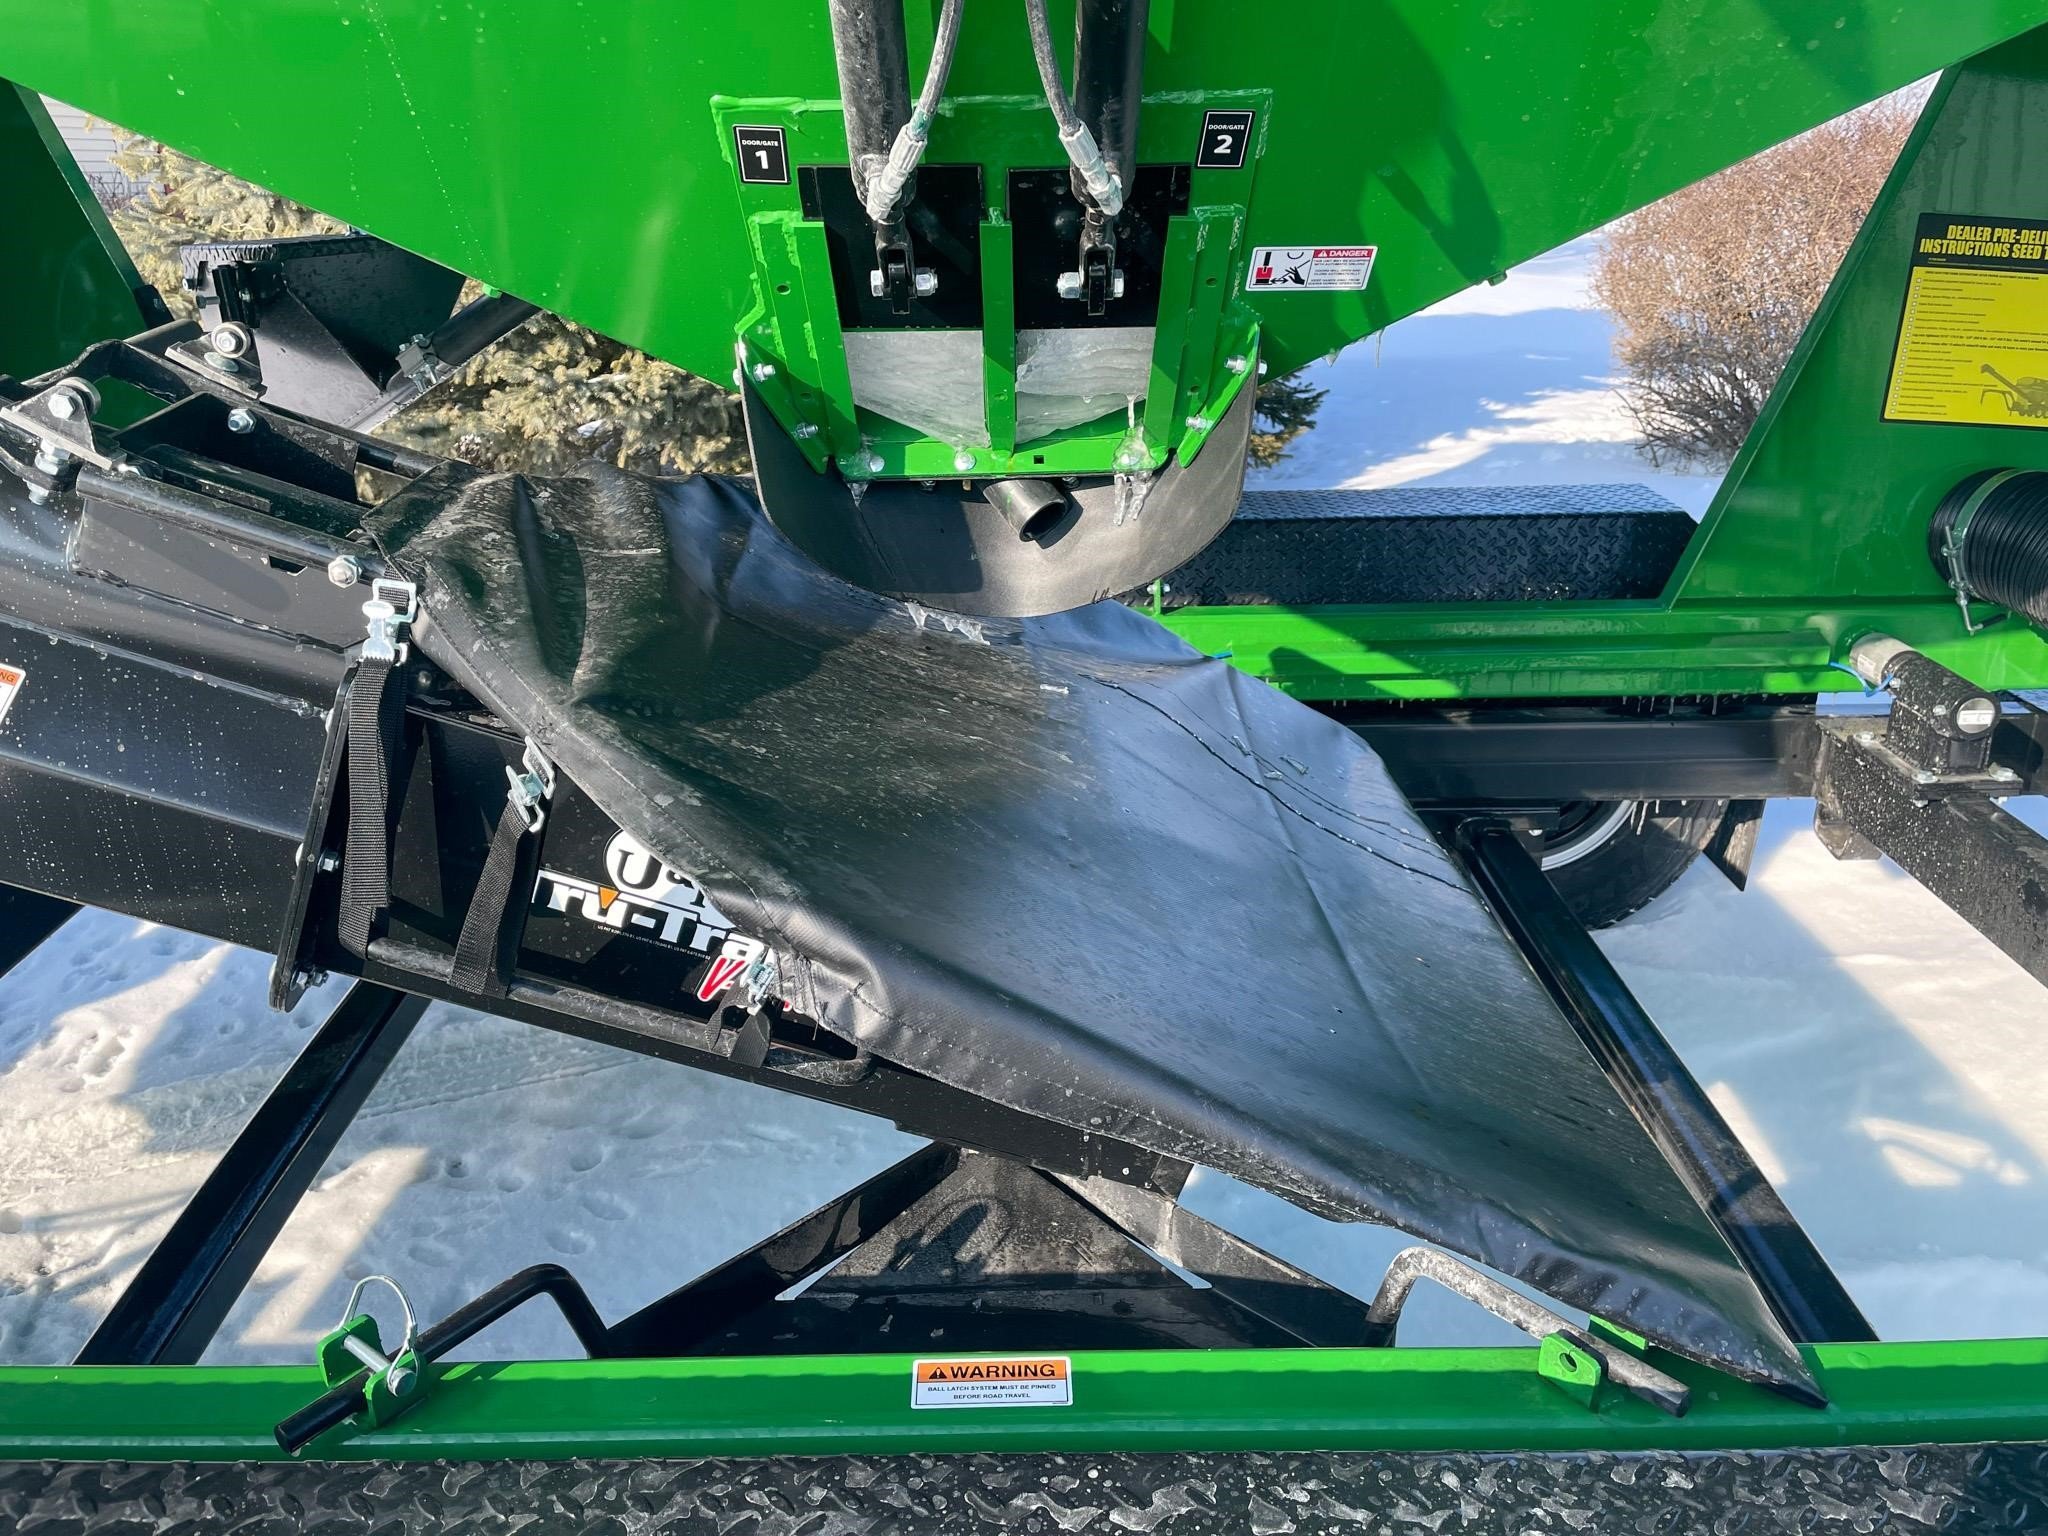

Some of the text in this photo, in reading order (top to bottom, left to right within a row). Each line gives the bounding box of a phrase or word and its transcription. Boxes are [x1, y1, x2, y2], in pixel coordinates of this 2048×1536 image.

[741, 139, 779, 147] DOOR/GATE
[1213, 134, 1233, 154] 2
[755, 150, 769, 170] 1
[1947, 225, 1992, 241] DEALER
[1919, 239, 2010, 258] INSTRUCTIONS
[2012, 244, 2043, 260] SEED
[950, 1363, 1056, 1379] WARNING
